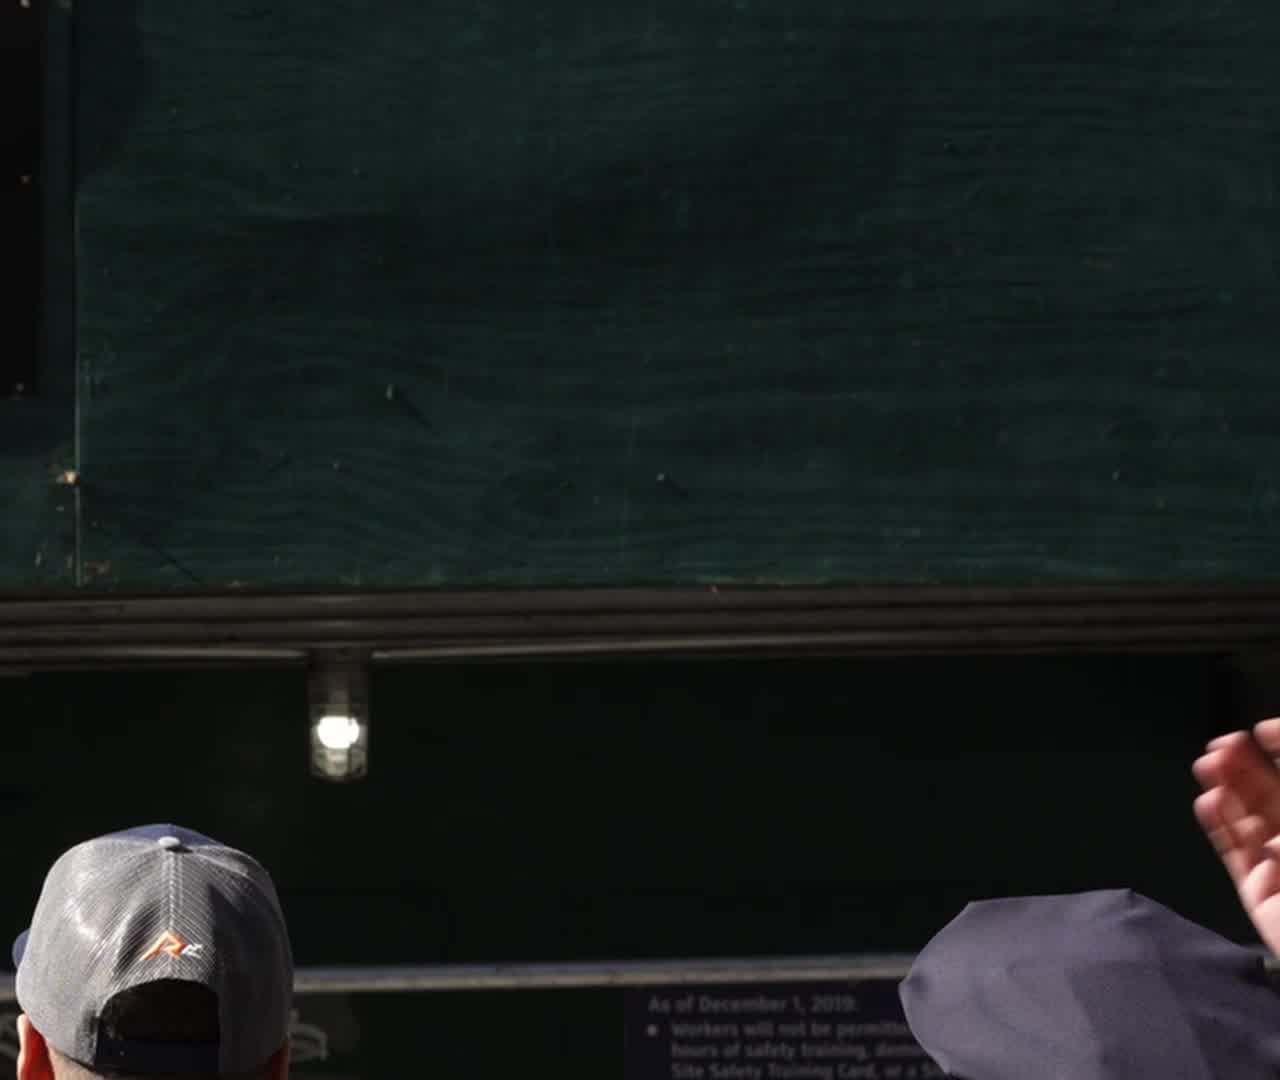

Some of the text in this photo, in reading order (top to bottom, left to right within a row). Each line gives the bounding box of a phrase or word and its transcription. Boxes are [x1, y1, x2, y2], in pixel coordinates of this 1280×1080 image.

[647, 994, 671, 1014] As
[674, 993, 695, 1013] of
[698, 994, 787, 1014] December
[671, 1021, 909, 1041] Workers will not be permitte
[672, 1041, 718, 1058] hours
[722, 1040, 740, 1058] of
[743, 1041, 796, 1060] safety
[671, 1062, 708, 1079] Site
